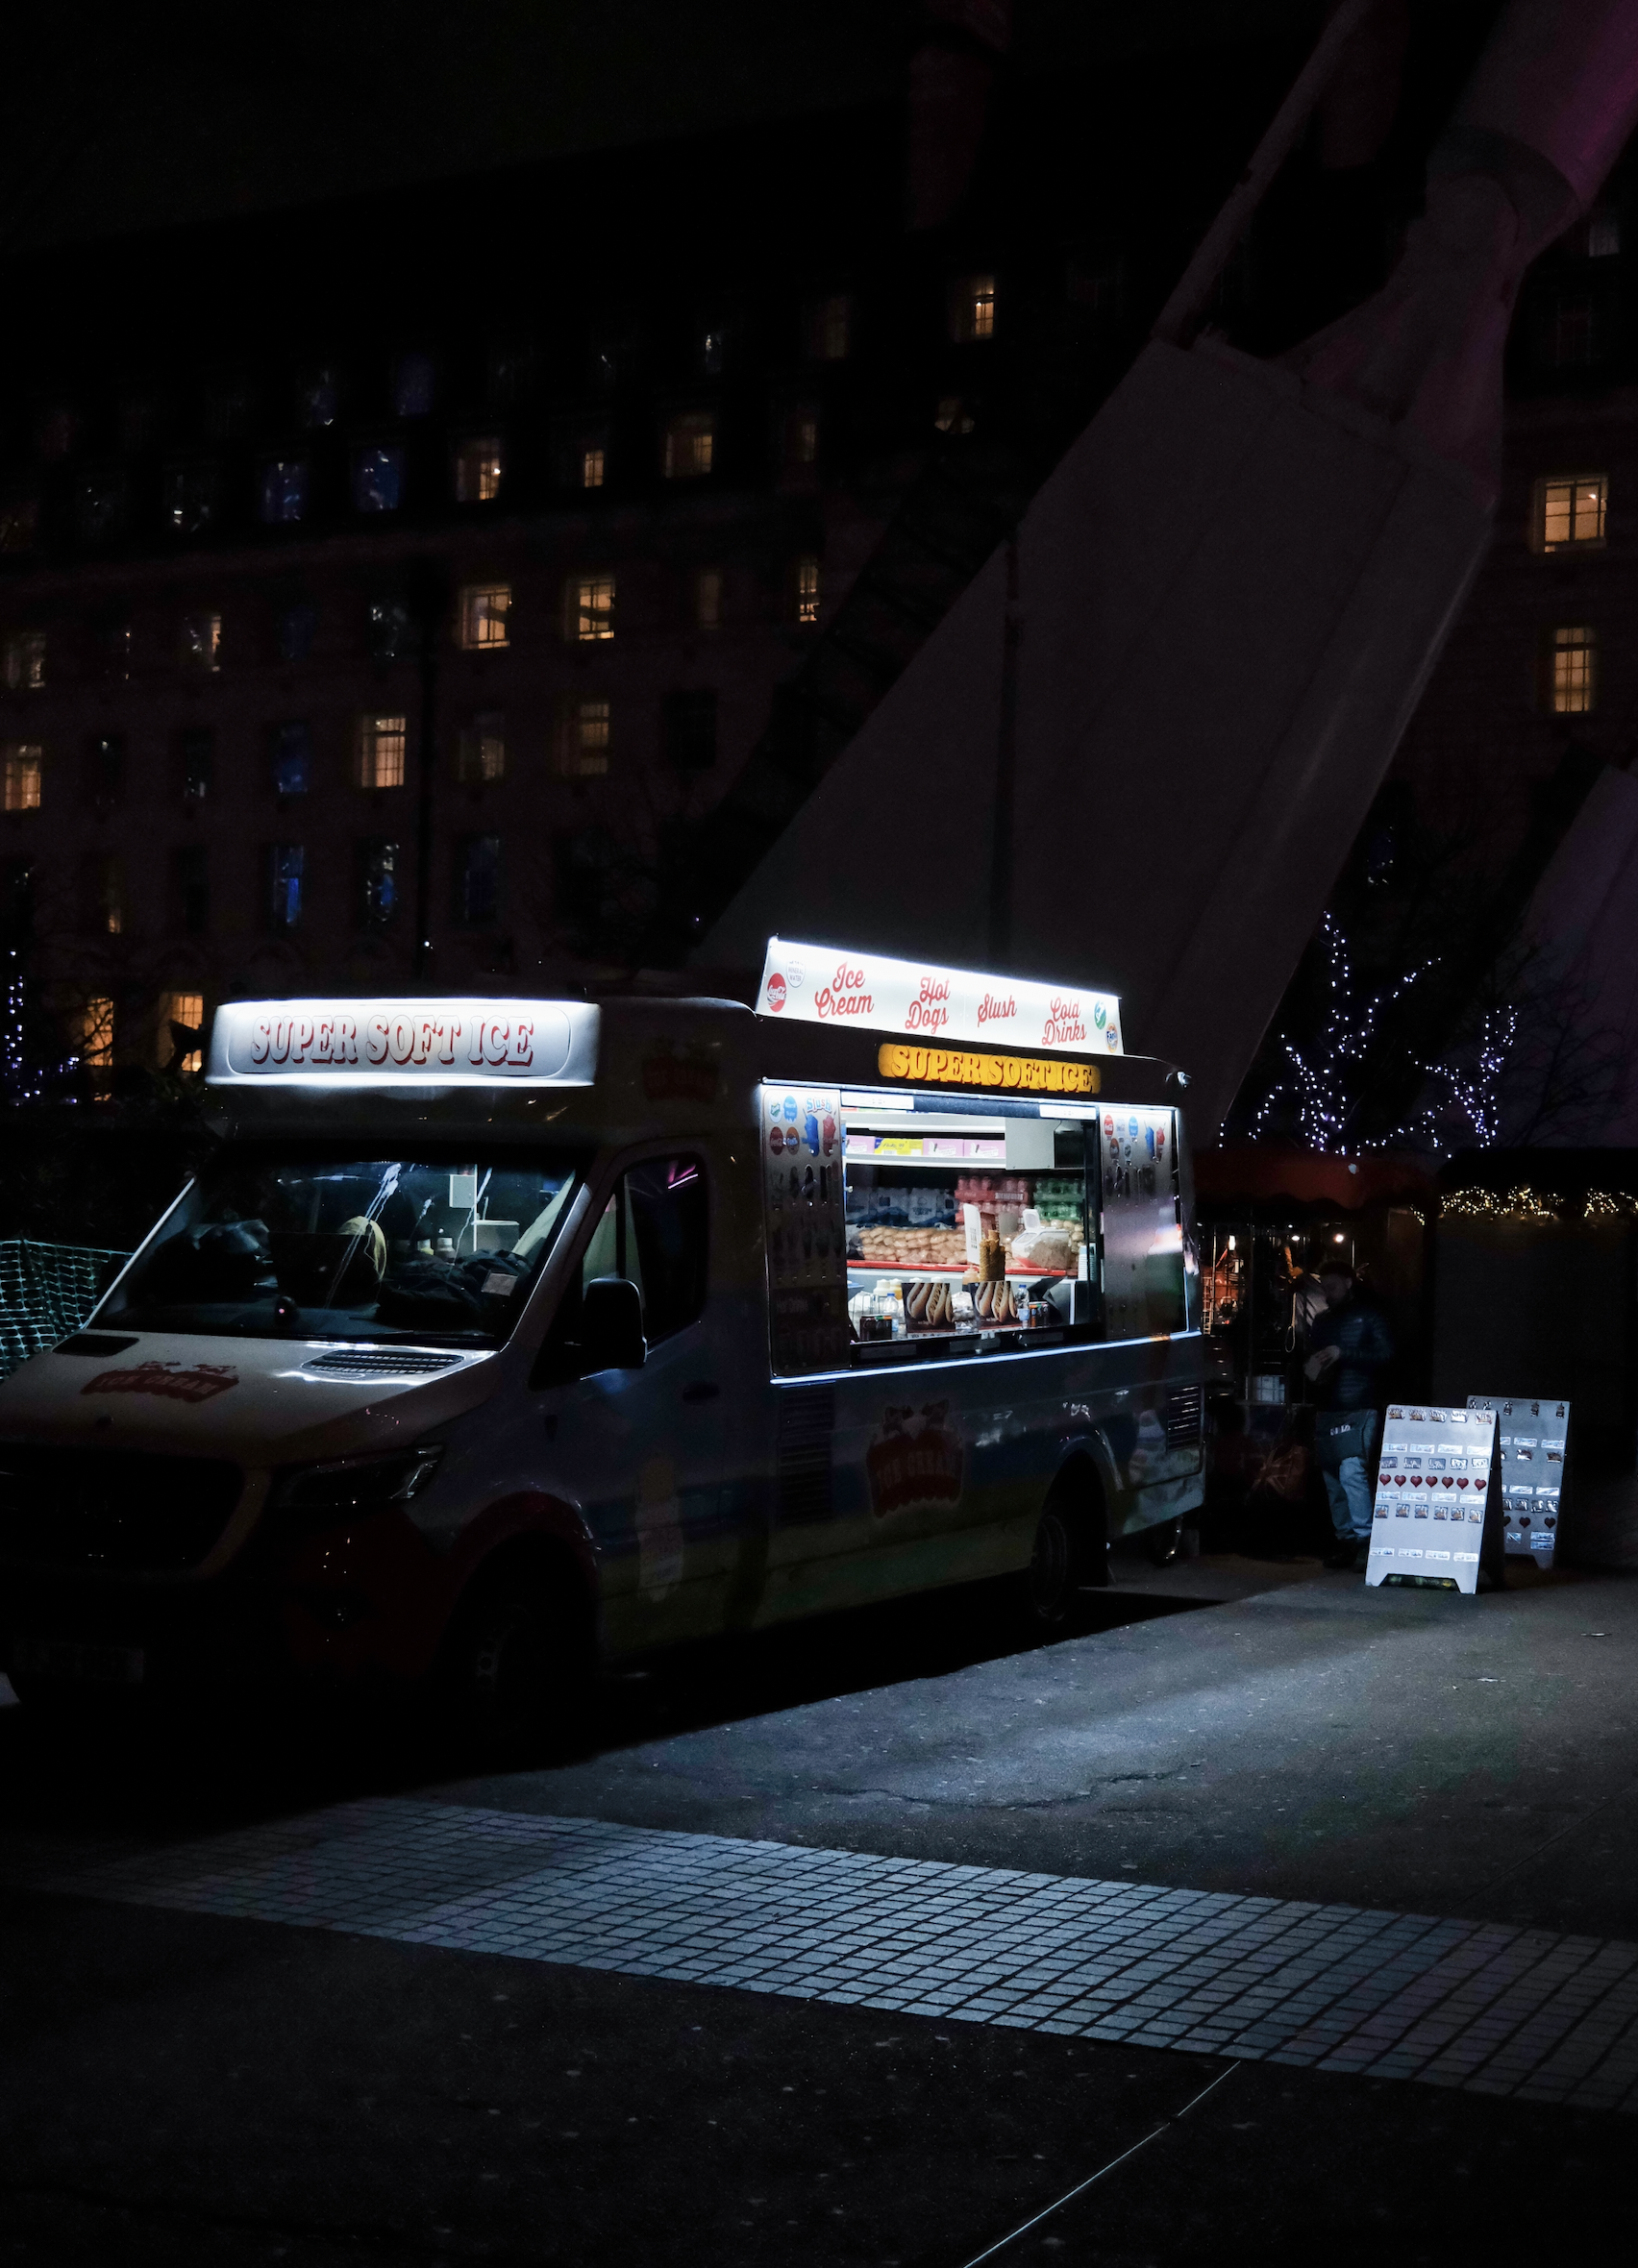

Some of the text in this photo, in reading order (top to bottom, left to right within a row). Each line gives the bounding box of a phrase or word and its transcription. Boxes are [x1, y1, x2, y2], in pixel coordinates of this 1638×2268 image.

[832, 961, 866, 991] Ice
[919, 975, 951, 1007] Hot
[814, 988, 874, 1020] Cream
[905, 1000, 950, 1035] Dogs
[977, 993, 1018, 1028] Slush
[1050, 996, 1081, 1023] Cold
[251, 1014, 534, 1068] SUPER SOFT ICE
[1042, 1019, 1087, 1047] Drinks
[891, 1045, 1094, 1094] SUPER SOFT ICE
[806, 1097, 832, 1114] Slush
